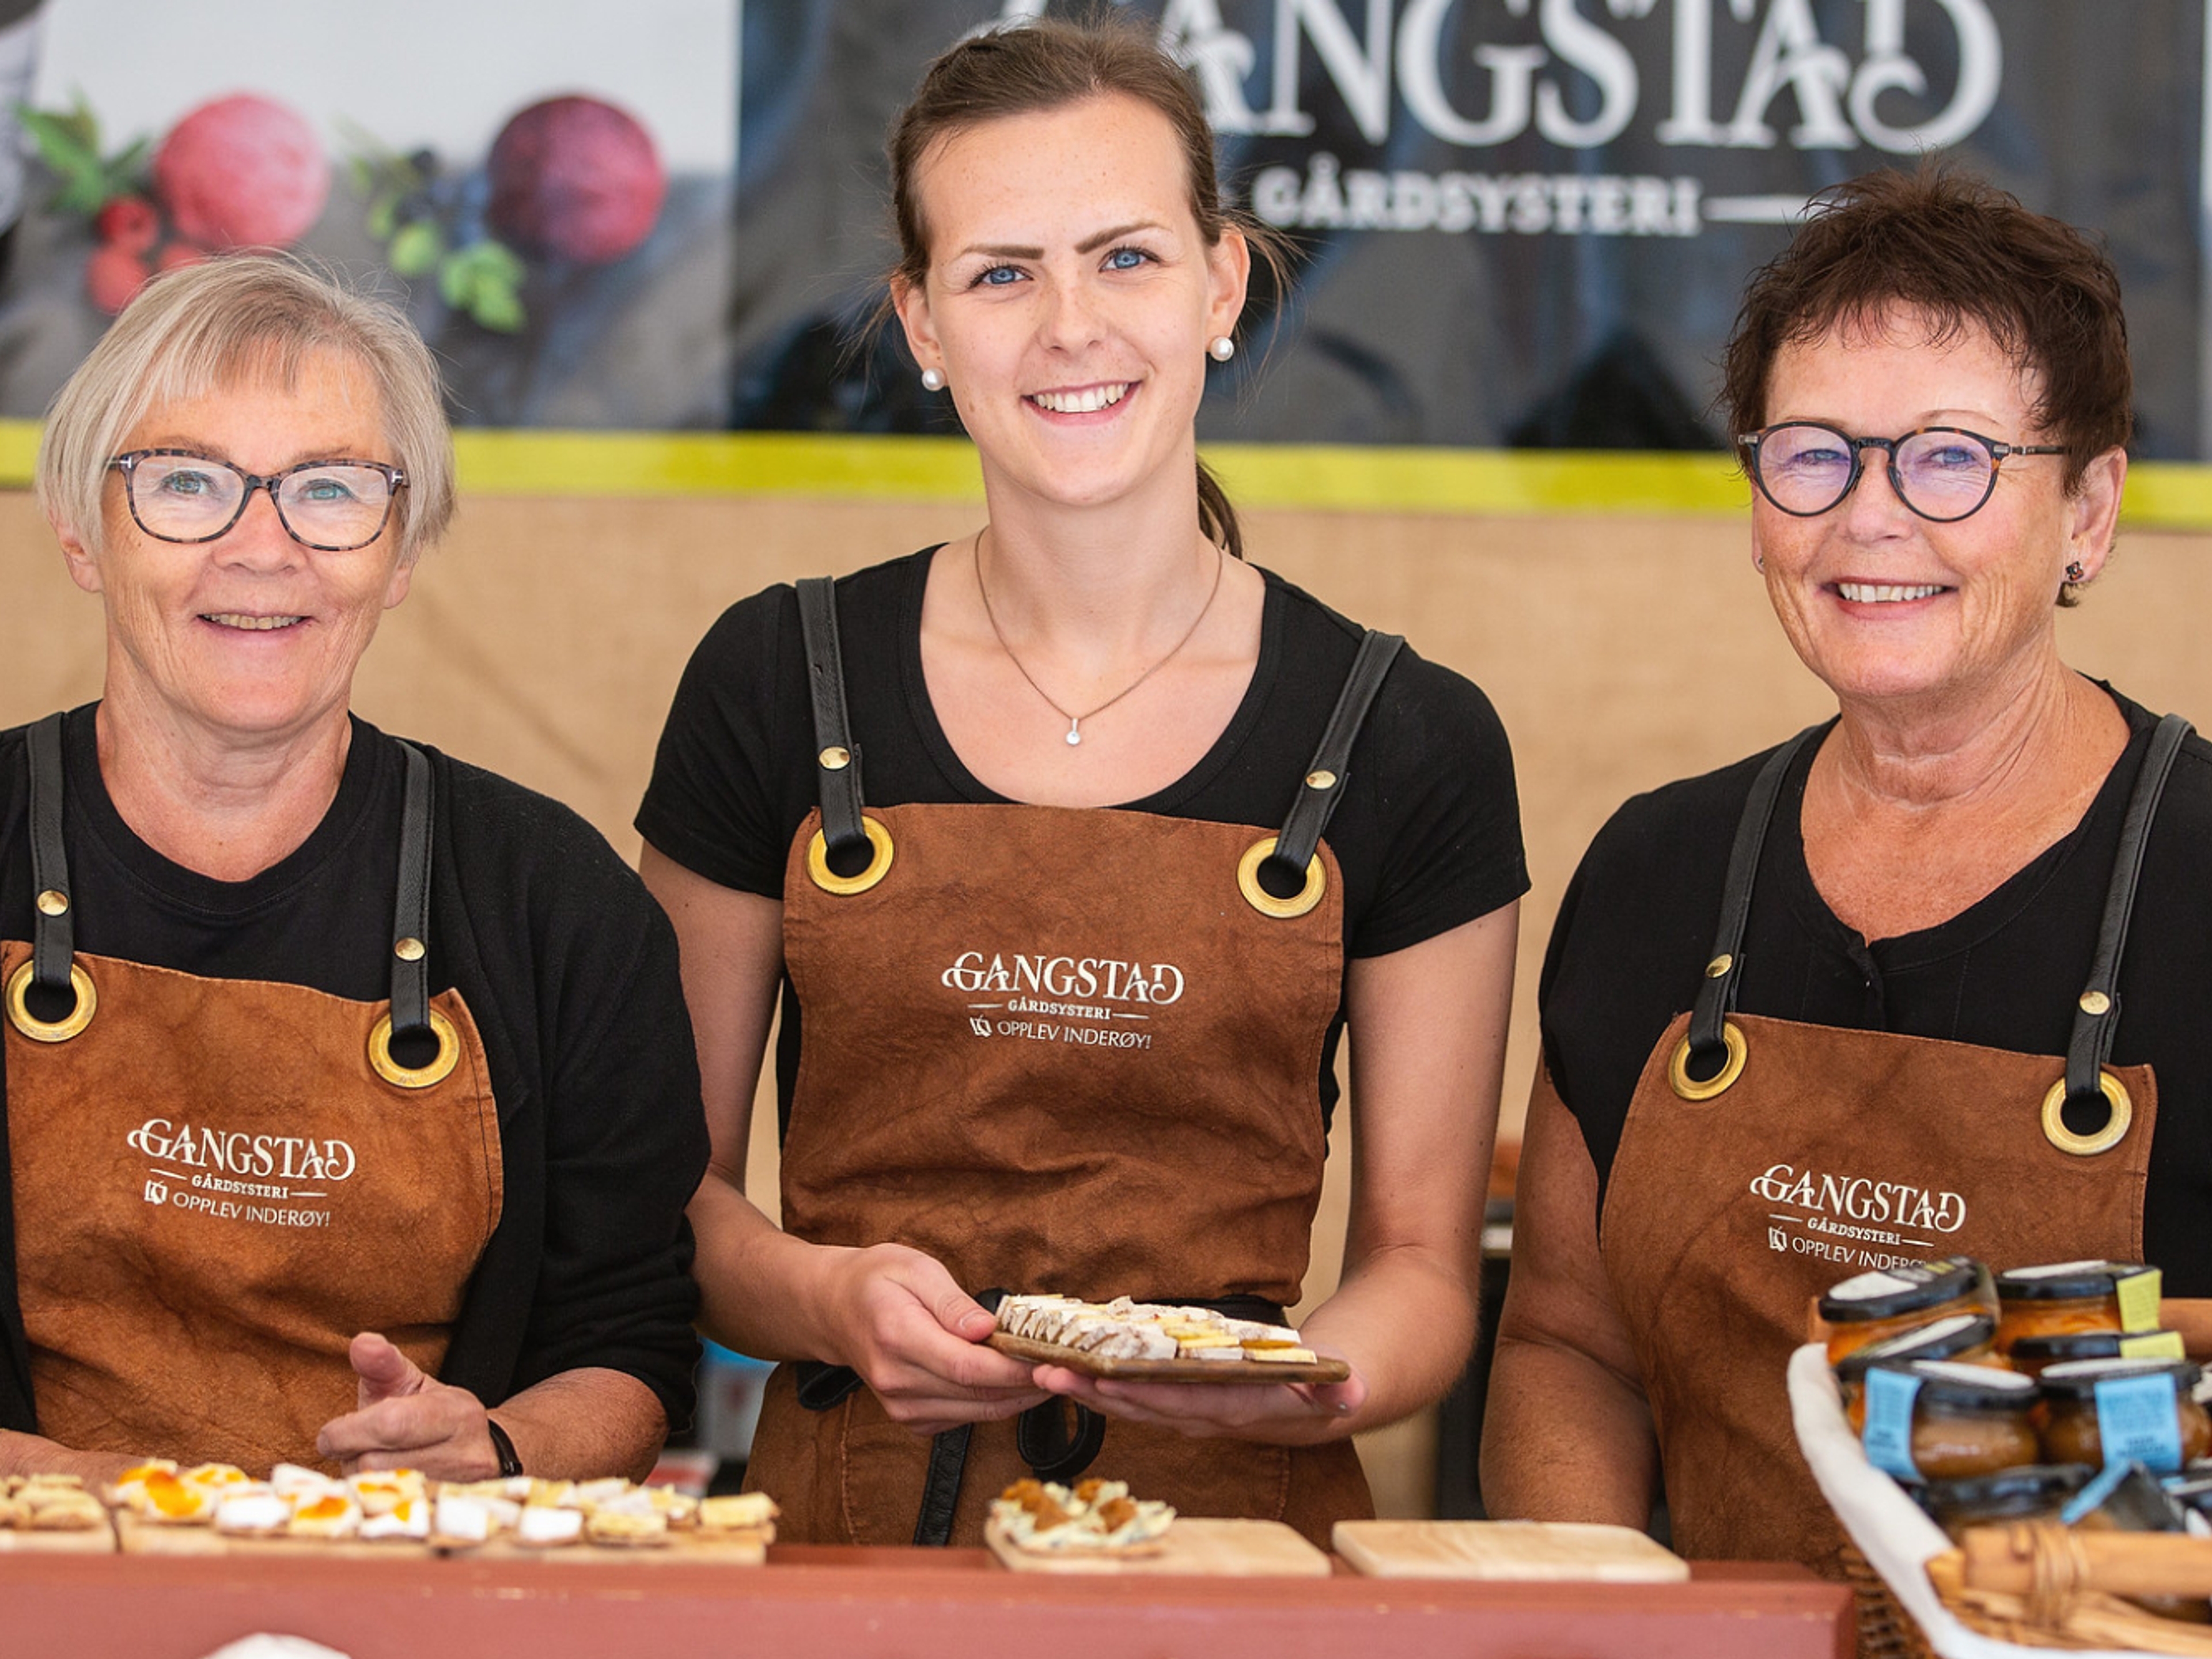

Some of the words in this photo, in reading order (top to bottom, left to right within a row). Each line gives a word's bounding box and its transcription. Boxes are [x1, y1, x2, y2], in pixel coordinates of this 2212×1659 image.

[959, 0, 2003, 155] ANGSTAD
[1252, 150, 1700, 237] GÅRDSYSTERI
[941, 952, 1184, 1005] GANGSTAD
[1007, 996, 1111, 1020] GÅRDSYSTERI
[997, 1020, 1060, 1041] OPPLEV
[1064, 1027, 1152, 1050] INDERØY!
[127, 1118, 356, 1180] GANGSTAD
[192, 1173, 289, 1199] GÅRDSYSTERI
[1749, 1164, 1966, 1233] GANGSTAD
[173, 1191, 243, 1219] OPPLEV
[246, 1205, 331, 1227] INDERØY!
[1807, 1217, 1901, 1245] GÅRDSYSTERI
[1792, 1237, 1855, 1263] OPPLEV
[1858, 1251, 1926, 1270] INDER
